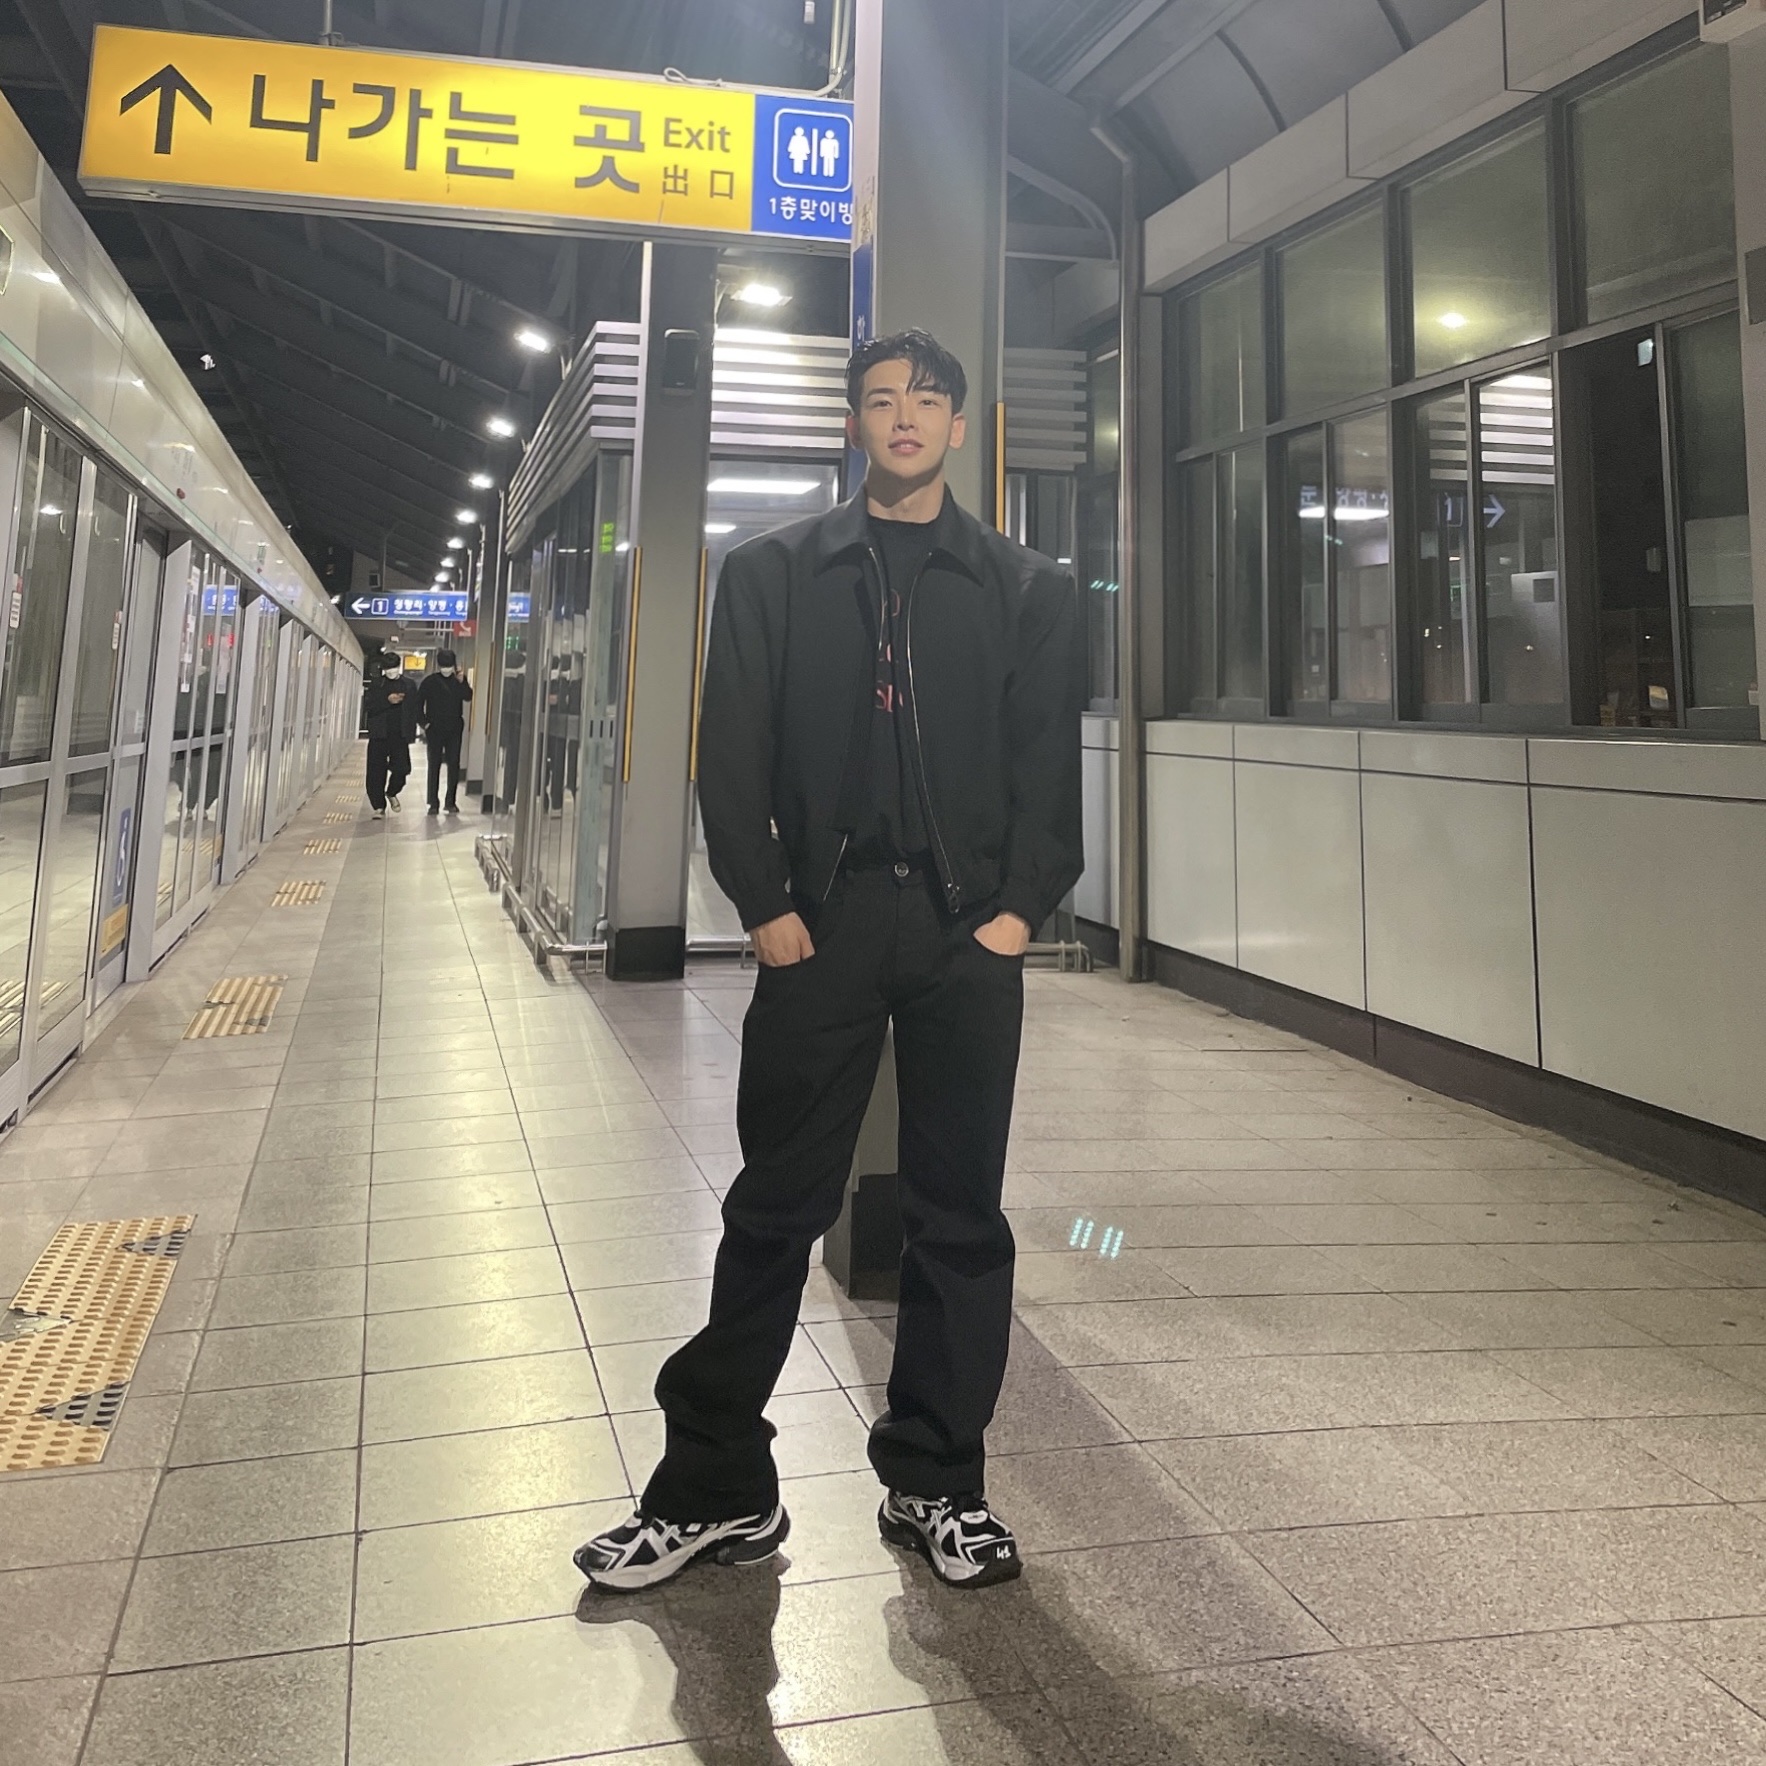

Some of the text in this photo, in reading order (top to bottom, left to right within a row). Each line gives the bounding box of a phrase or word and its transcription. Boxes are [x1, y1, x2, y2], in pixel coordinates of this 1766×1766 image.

[249, 74, 646, 194] 나가는 곳
[663, 117, 731, 153] Exit
